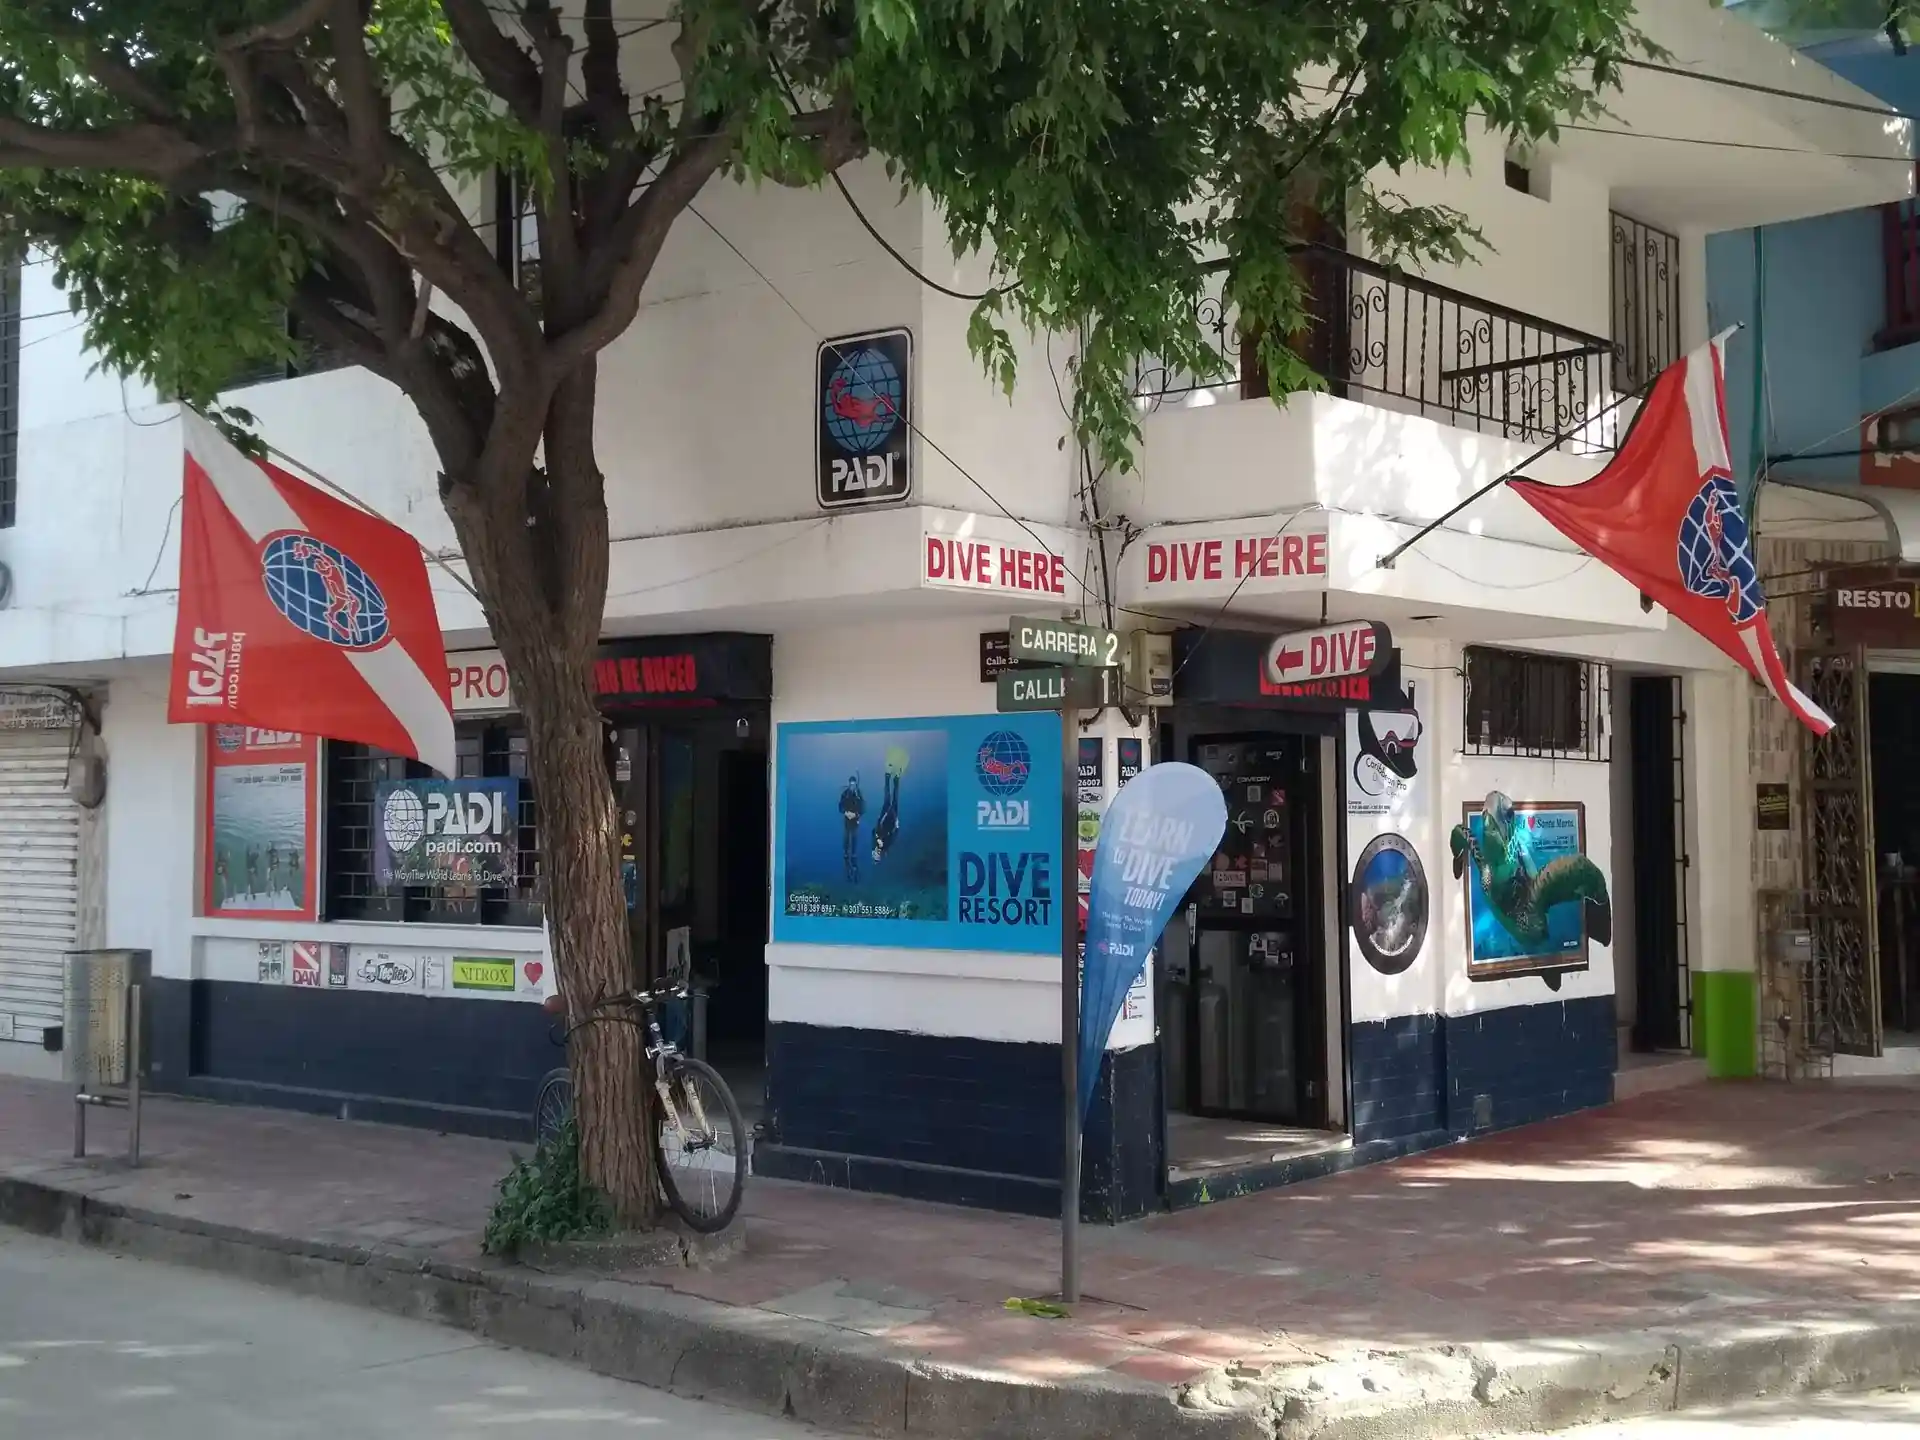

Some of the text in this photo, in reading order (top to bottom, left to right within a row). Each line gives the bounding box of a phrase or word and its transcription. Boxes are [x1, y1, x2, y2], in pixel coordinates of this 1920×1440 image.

[832, 452, 893, 492] PADI
[927, 537, 1065, 593] DIVE HERE
[1148, 533, 1327, 583] DIVE HERE
[1837, 589, 1911, 609] RESTO
[1021, 627, 1119, 667] CARRERA 2
[1310, 628, 1376, 675] DIVE
[450, 664, 508, 699] PRO
[426, 791, 502, 835] PADI
[977, 800, 1029, 826] PADI
[426, 839, 502, 857] padi.com
[1119, 810, 1195, 857] LEARN
[959, 851, 1051, 898] DIVE
[1122, 848, 1179, 890] DIVE
[959, 897, 1052, 926] RESORT
[1123, 886, 1167, 912] TODAY!
[1108, 942, 1134, 957] PADI
[292, 969, 321, 987] DAN
[460, 966, 509, 984] NITROX
